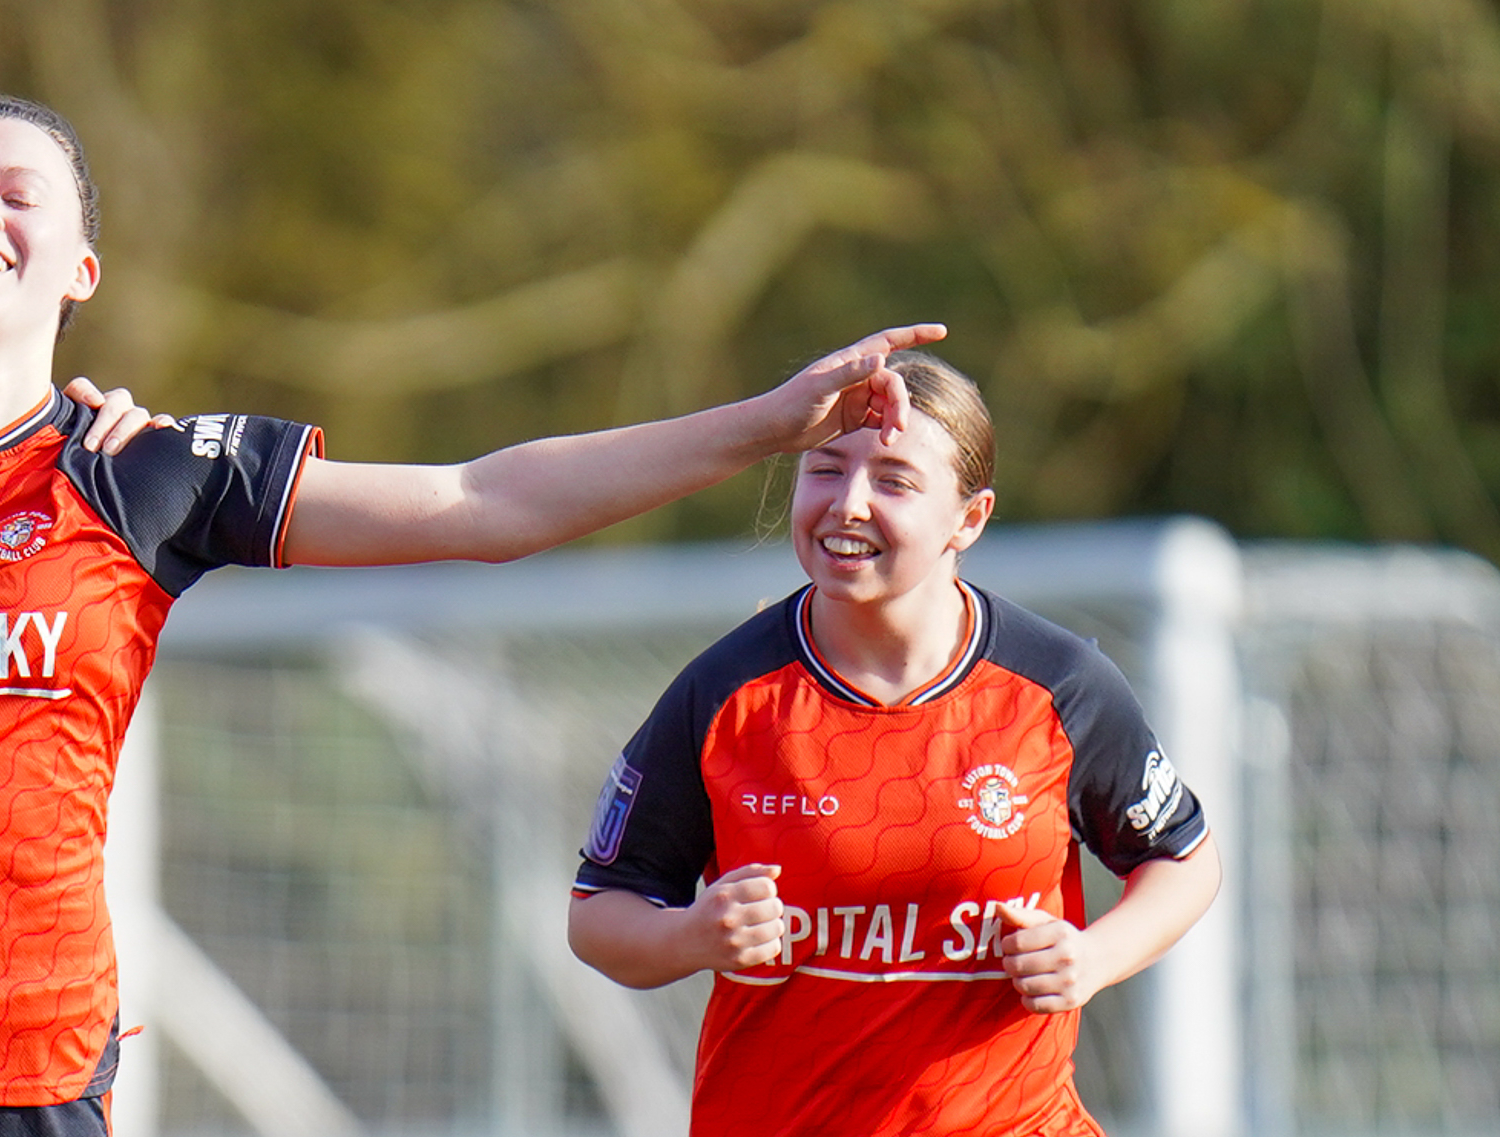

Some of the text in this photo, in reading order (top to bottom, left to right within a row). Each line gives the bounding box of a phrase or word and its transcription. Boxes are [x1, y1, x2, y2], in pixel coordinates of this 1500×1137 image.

[741, 793, 840, 817] REFLO
[765, 891, 1041, 966] PITAL SK
